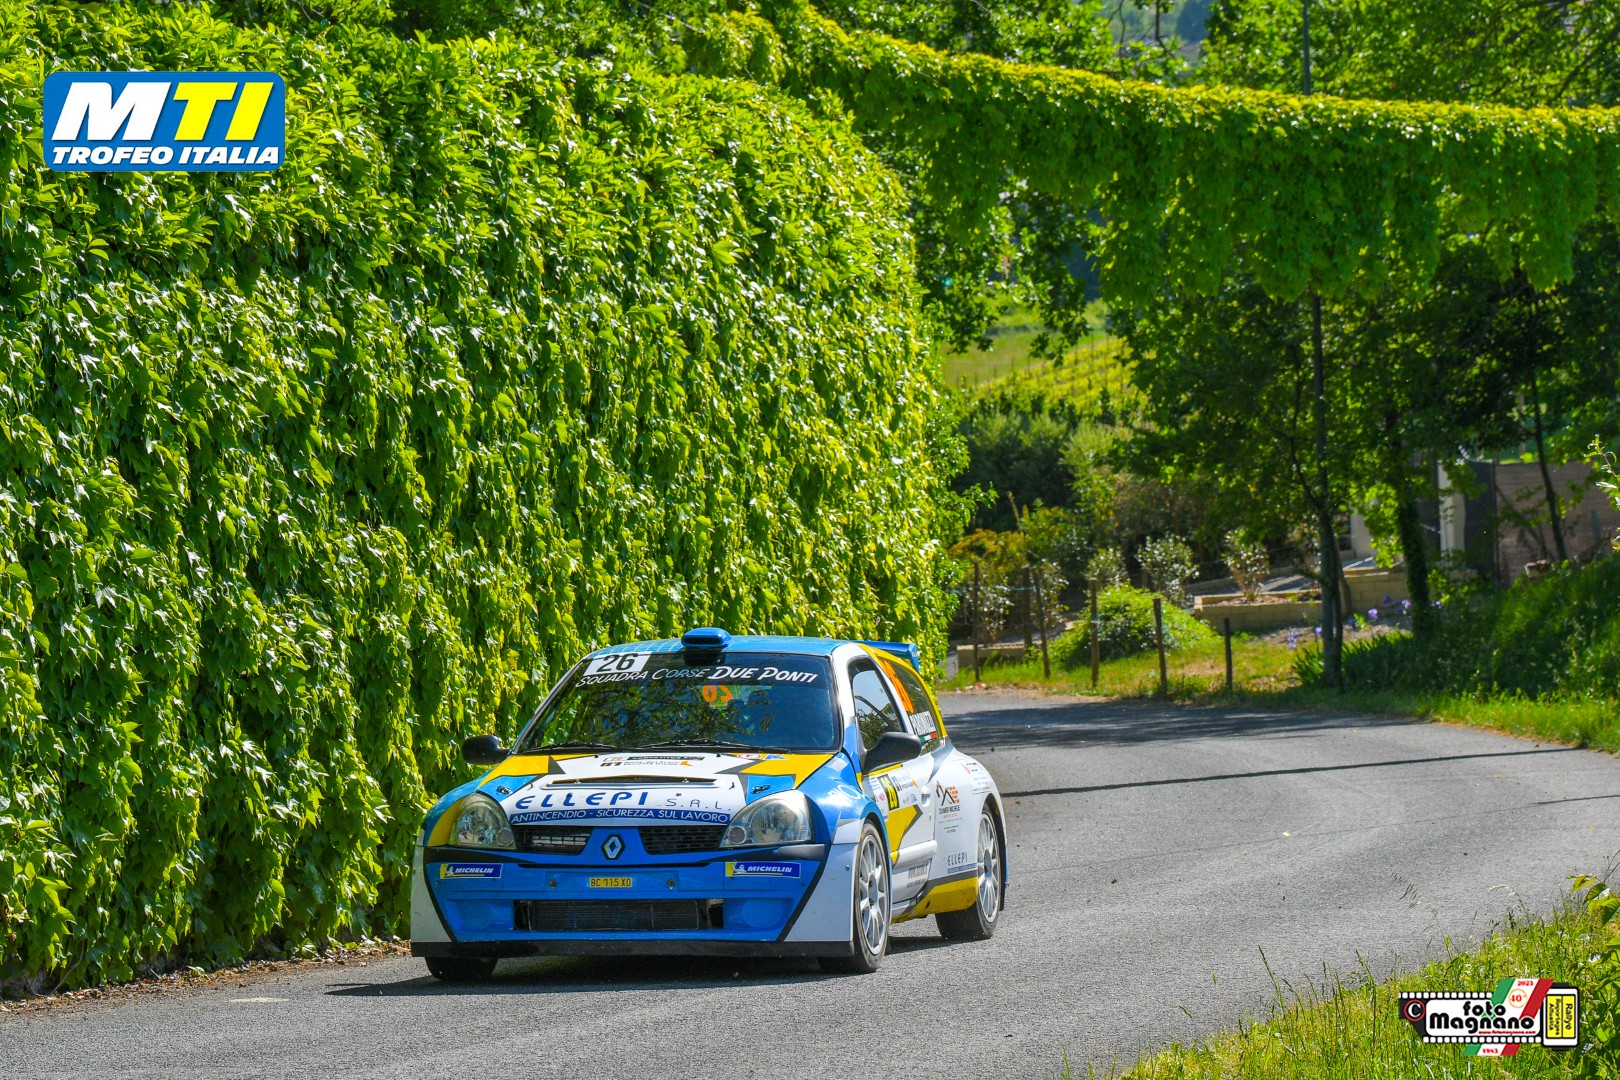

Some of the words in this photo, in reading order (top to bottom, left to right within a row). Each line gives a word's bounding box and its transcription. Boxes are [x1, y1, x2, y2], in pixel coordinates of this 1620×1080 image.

[596, 653, 639, 673] 26
[575, 670, 649, 688] SQUADRA
[652, 668, 710, 680] CORSE
[707, 666, 759, 680] DUE
[757, 667, 818, 683] PONTI
[515, 791, 649, 810] ELLEPI
[511, 809, 586, 824] ANTINCENDIO
[596, 807, 655, 818] SICUREZZA
[658, 809, 677, 819] SUL
[680, 811, 728, 823] LAVORO
[747, 865, 793, 873] MICHELIN
[590, 878, 601, 887] BC
